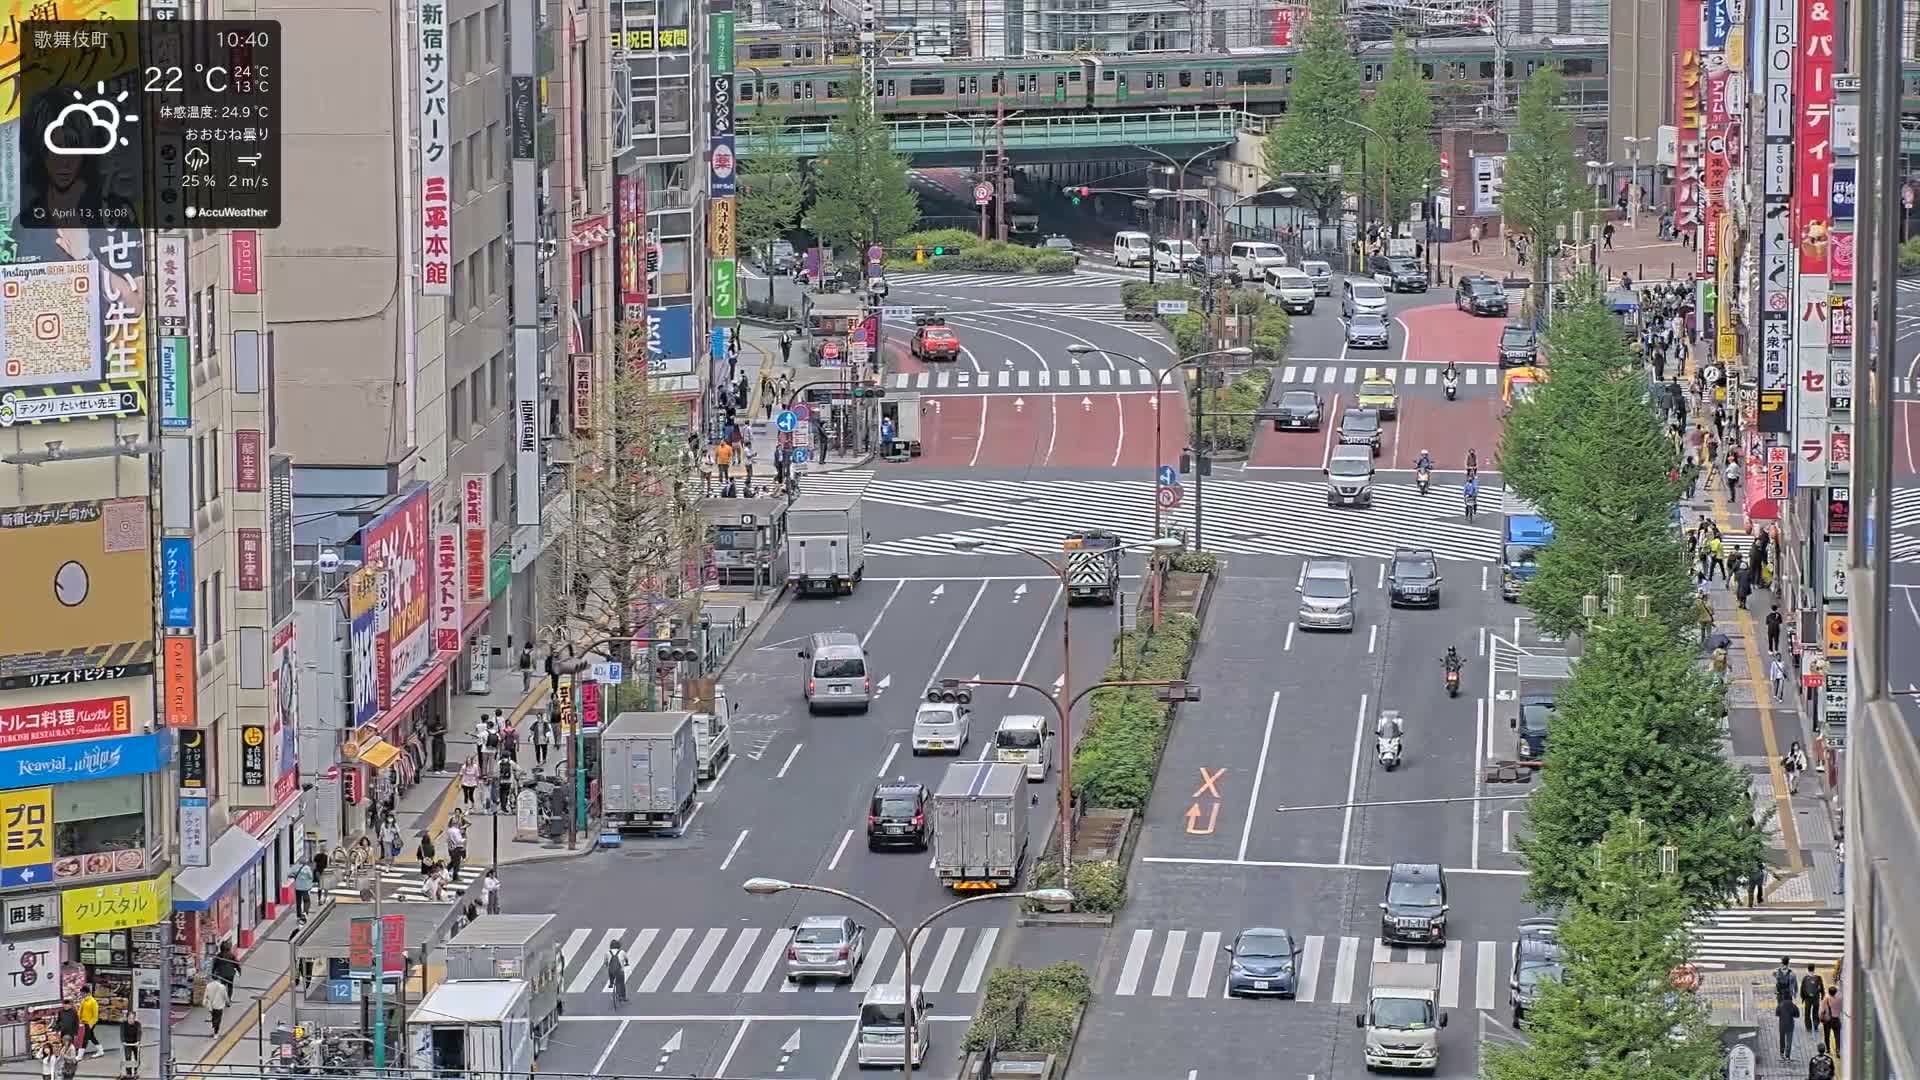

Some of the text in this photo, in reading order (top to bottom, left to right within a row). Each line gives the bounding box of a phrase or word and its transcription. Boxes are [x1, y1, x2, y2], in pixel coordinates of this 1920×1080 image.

[156, 10, 174, 20] 6F
[626, 31, 652, 48] 祝日
[659, 29, 687, 47] 夜間
[422, 4, 445, 163] 新宿サンパーク
[1682, 50, 1699, 129] パチンコ
[1712, 80, 1725, 113] アコム
[1776, 145, 1784, 193] ESOLA
[425, 177, 448, 284] 三平本館
[716, 269, 730, 307] レイク
[164, 317, 182, 326] 3F
[1766, 322, 1780, 375] 大衆酒場
[163, 346, 175, 407] FamilyMart
[1801, 301, 1828, 462] パセラ
[19, 398, 117, 413] テンクリ たいせい先生
[521, 400, 534, 453] HOMEGAME
[1835, 490, 1847, 499] 3F
[1, 507, 100, 527] 新宿ピカデリー向かい
[720, 535, 732, 545] 10
[167, 547, 178, 600] ゲウチャイ
[440, 535, 456, 622] 三平ストア
[31, 667, 125, 686] リアエイド ビジョン
[0, 708, 75, 732] トルコ料理
[115, 703, 125, 729] 5F
[31, 727, 75, 739] RESTAURANT
[6, 804, 45, 826] プロ
[7, 830, 45, 851] ミス
[10, 905, 45, 924] 囲碁
[76, 896, 148, 920] クリスタル
[336, 983, 349, 997] 12
